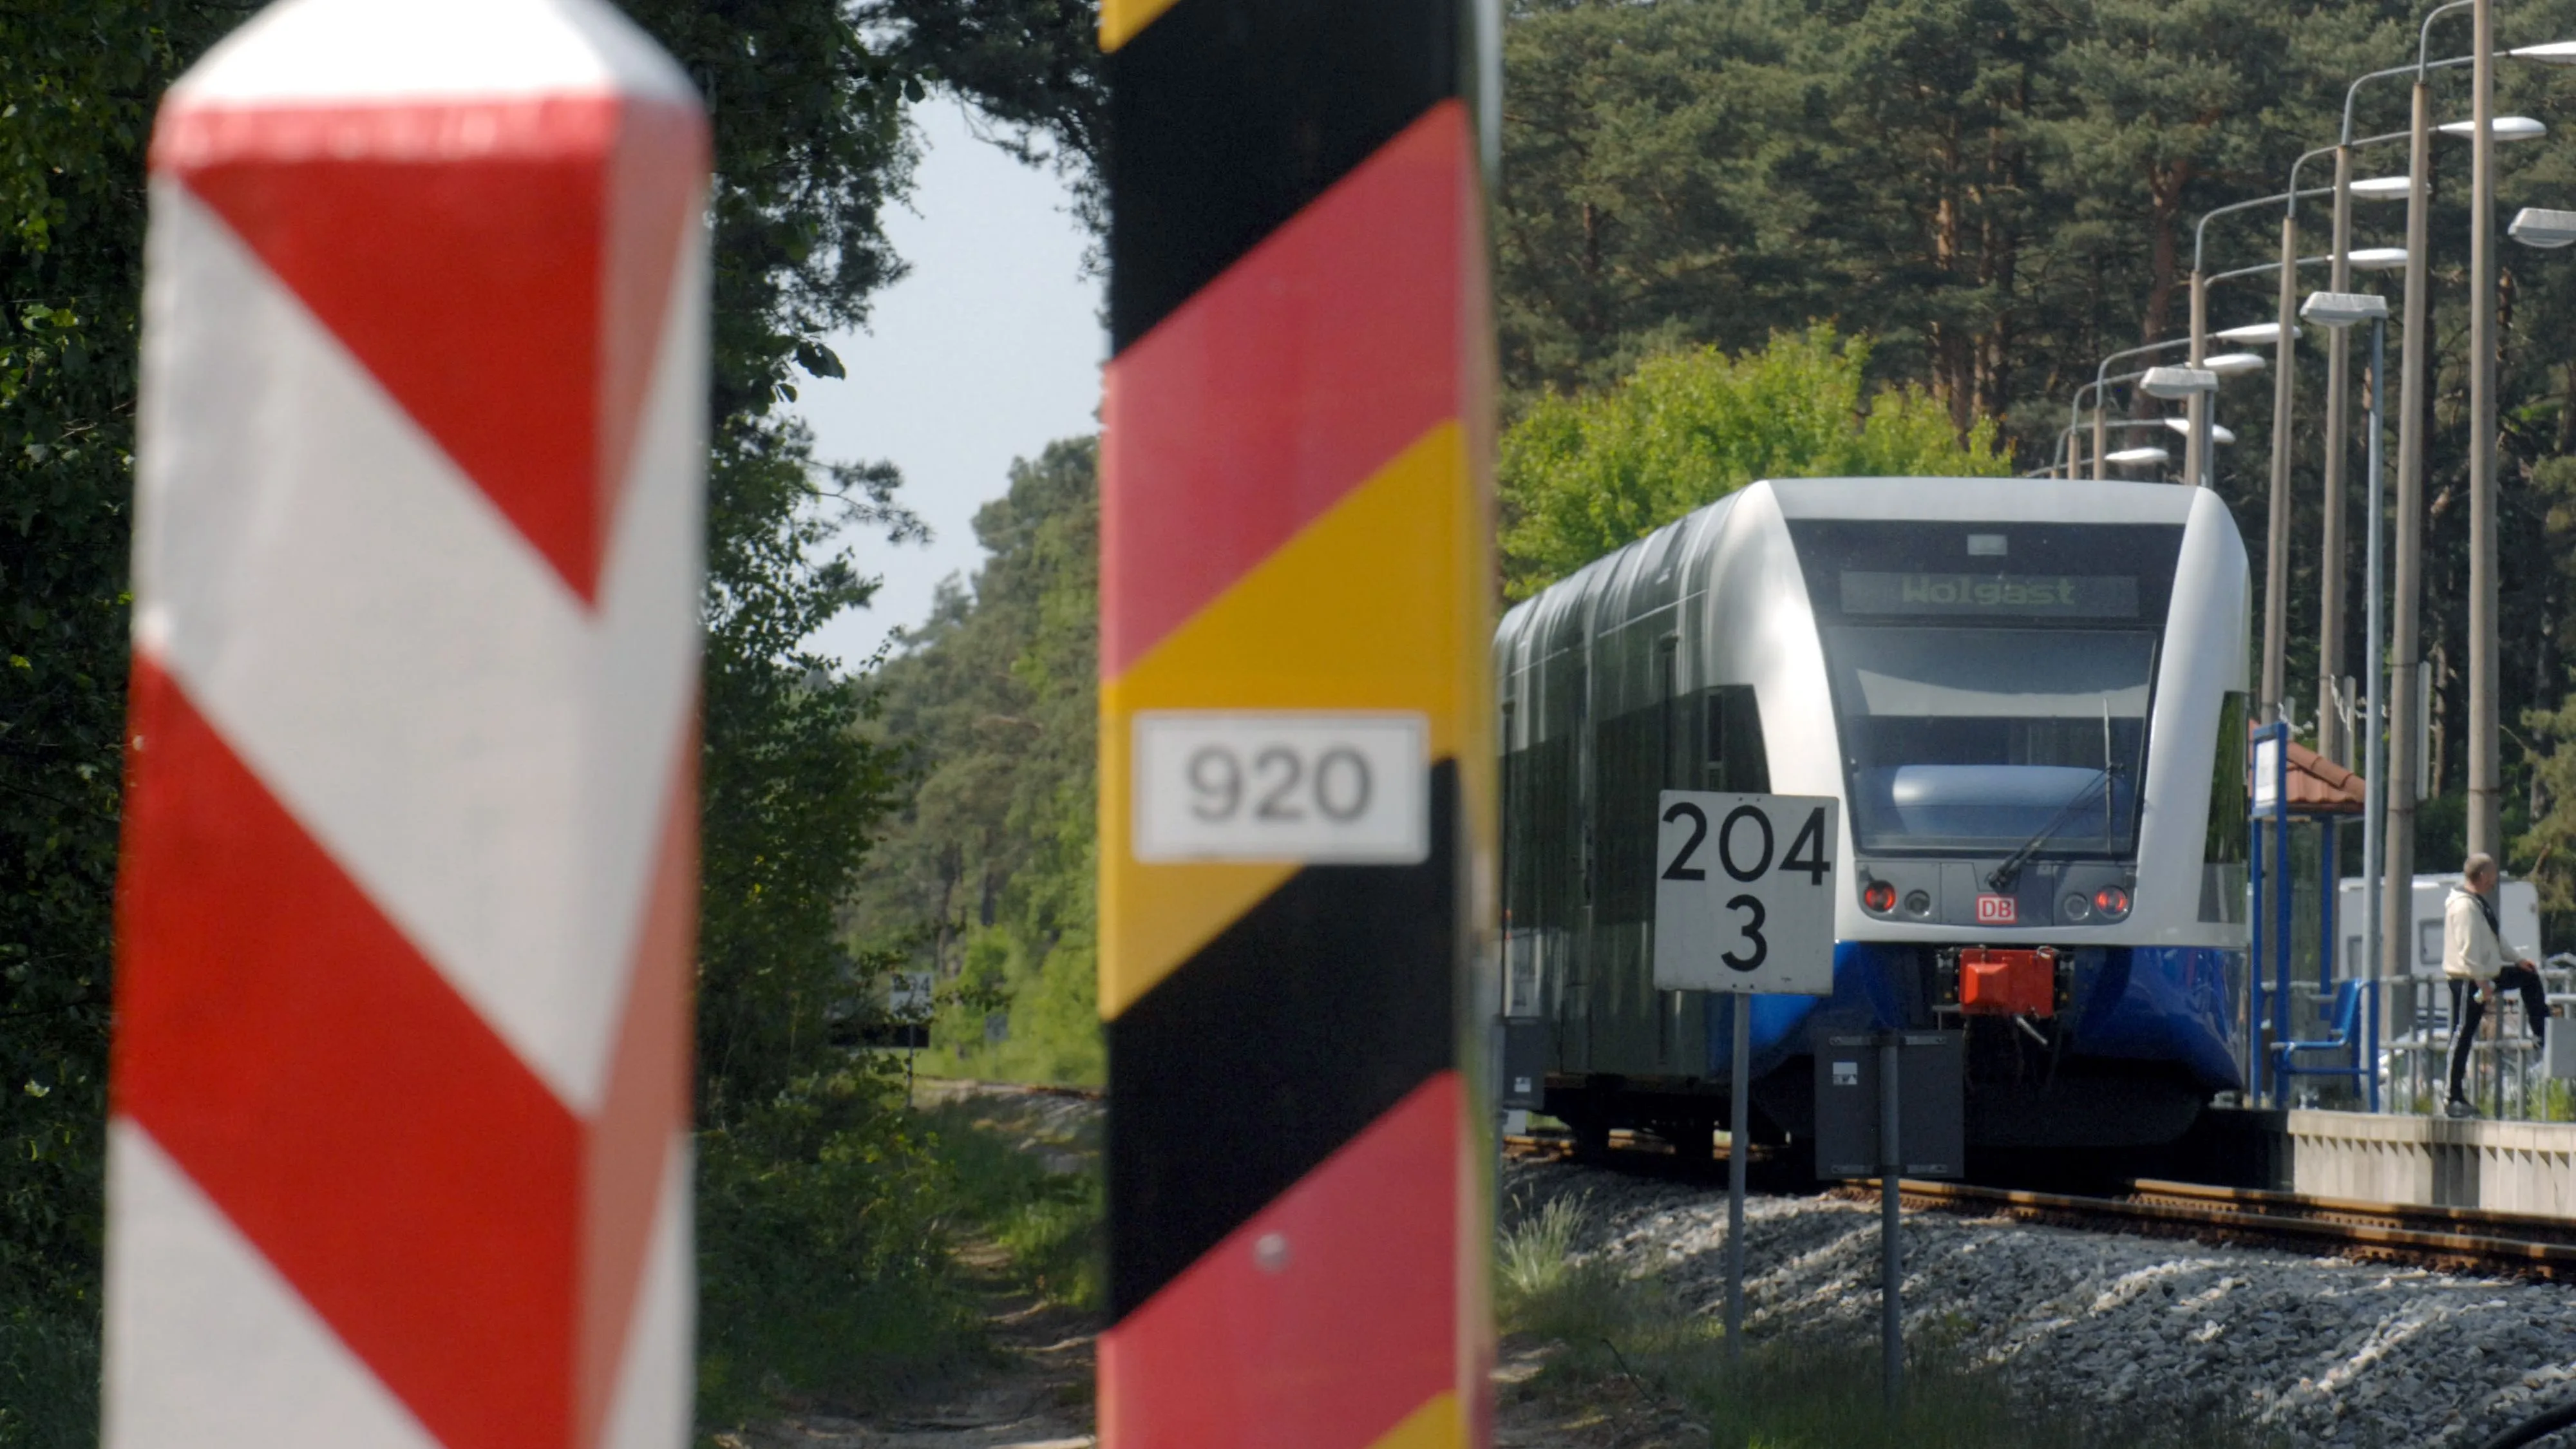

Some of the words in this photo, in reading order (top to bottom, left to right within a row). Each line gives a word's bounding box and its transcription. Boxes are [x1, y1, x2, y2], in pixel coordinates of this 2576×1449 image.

[1902, 574, 2076, 606] Wolgast
[1186, 743, 1372, 822] 920
[1662, 801, 1830, 886] 204
[1721, 894, 1768, 972] 3
[1982, 900, 2012, 918] DB
